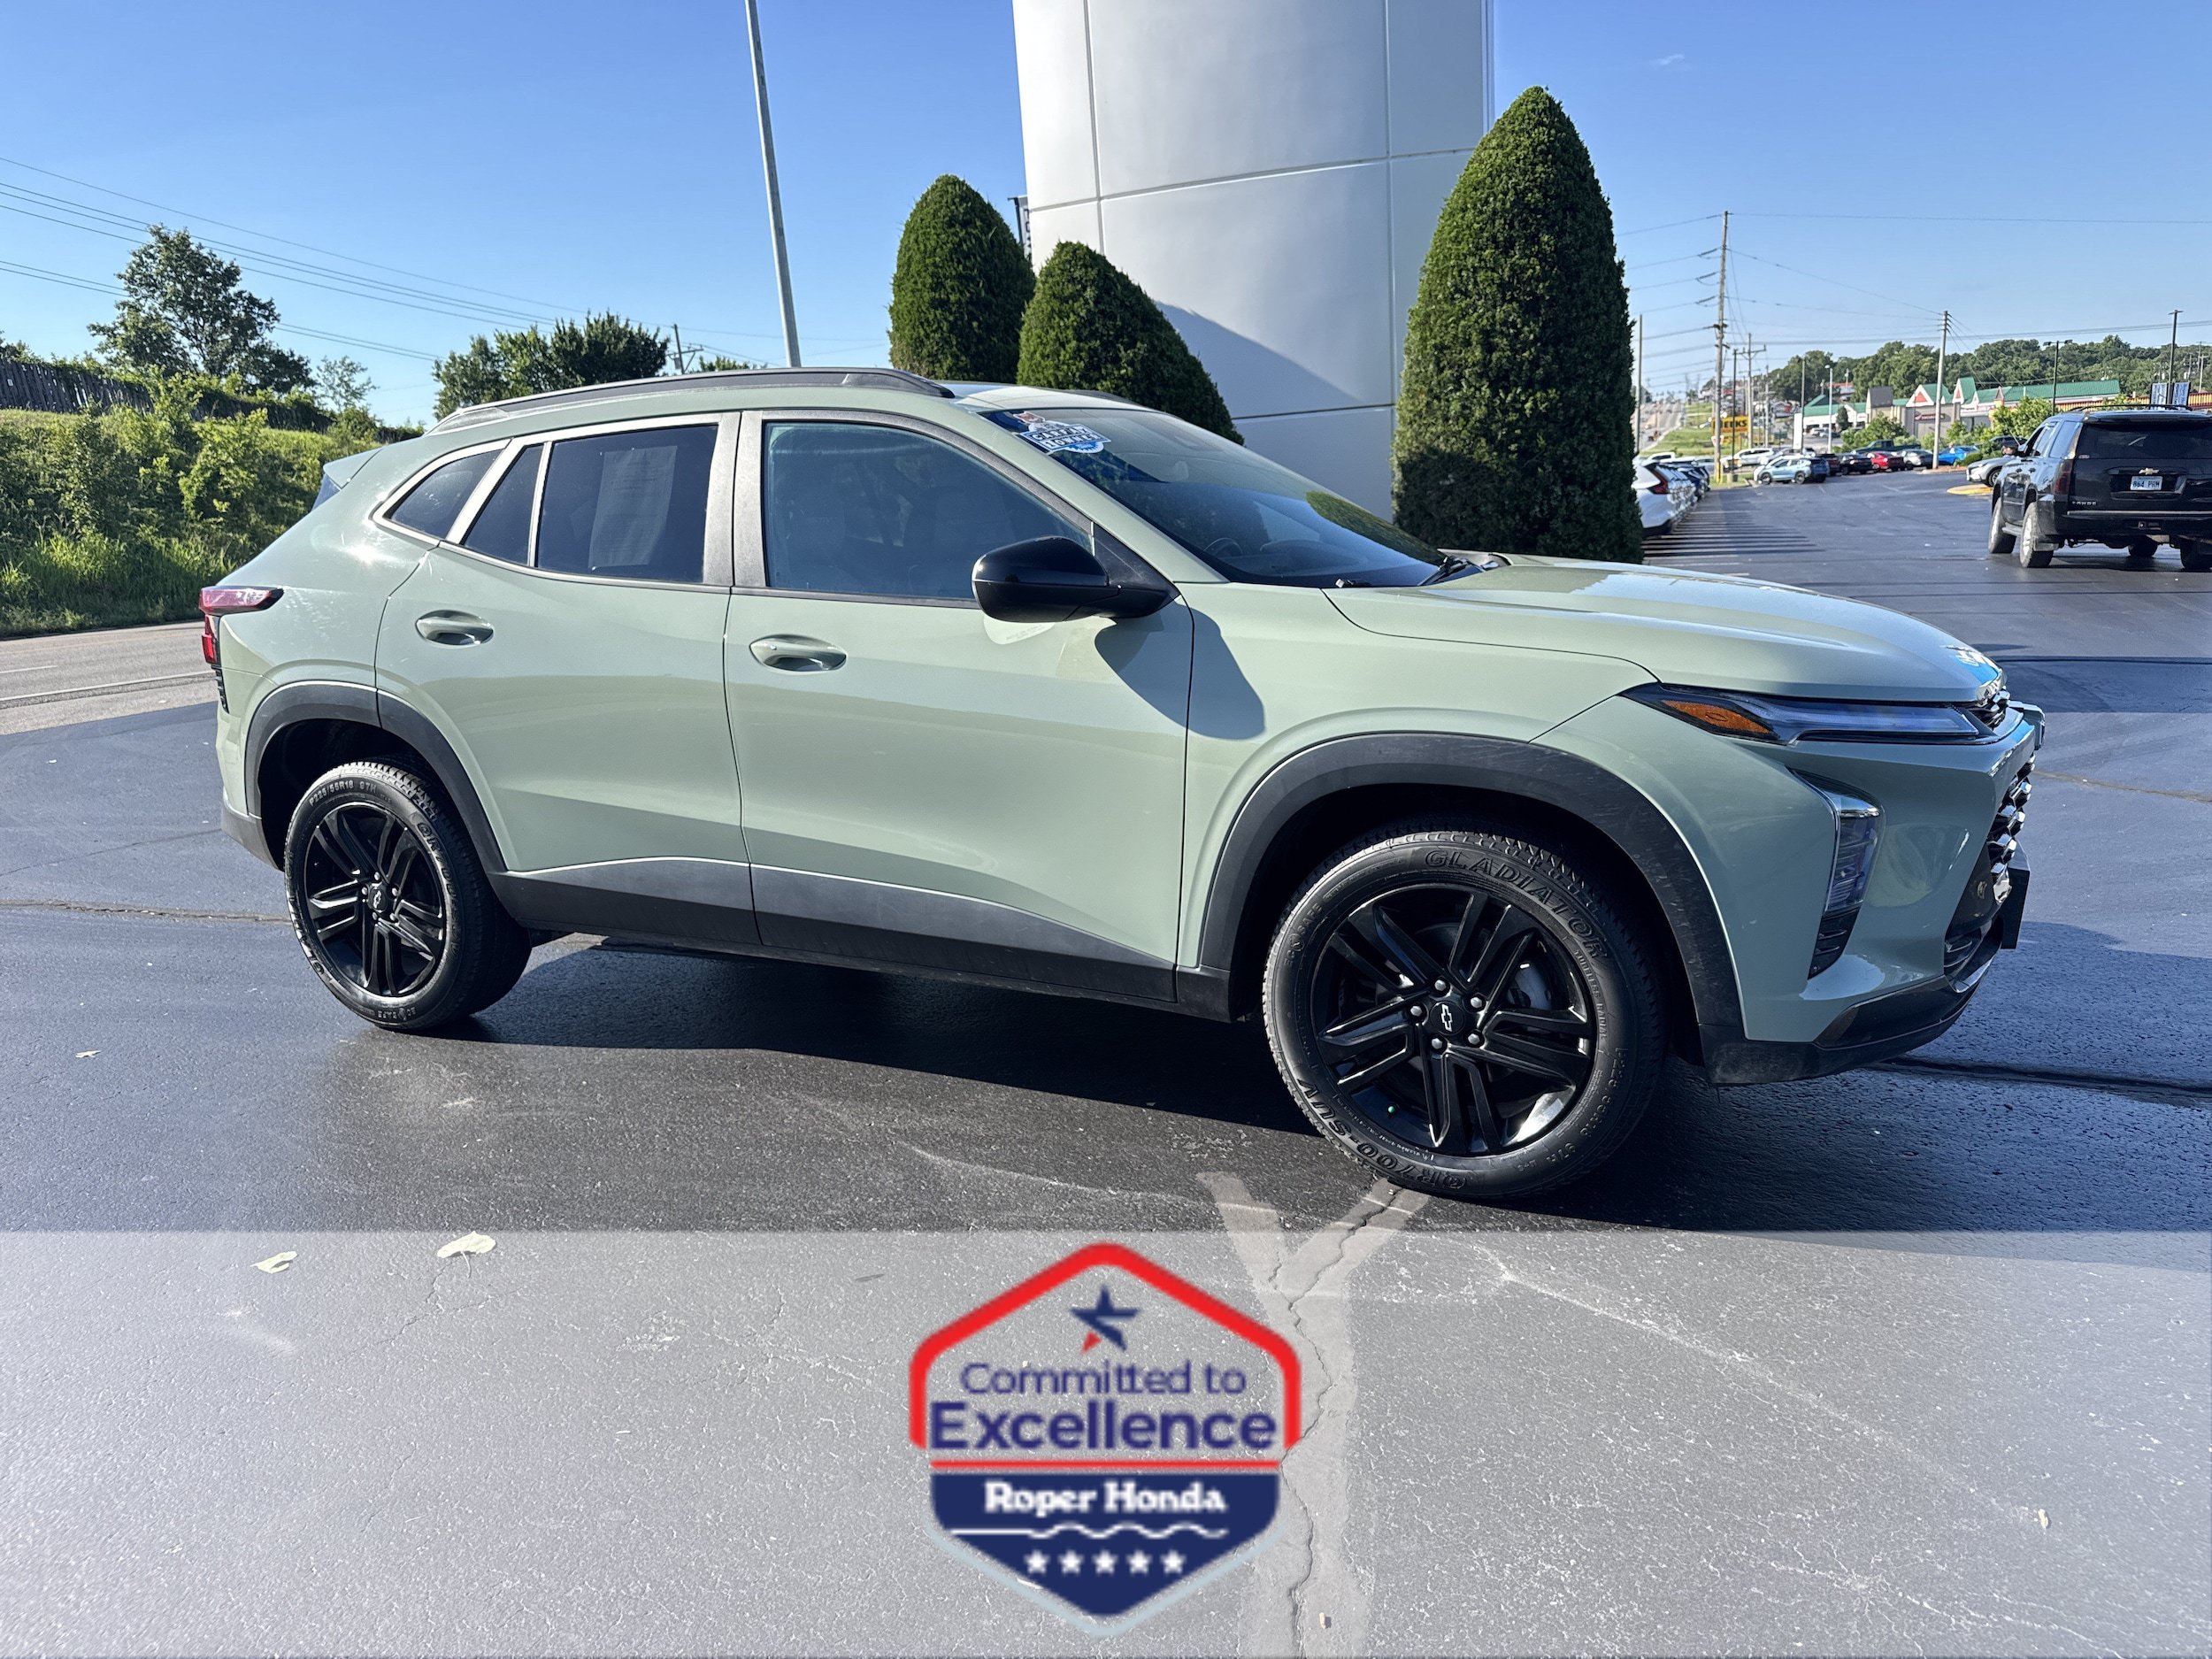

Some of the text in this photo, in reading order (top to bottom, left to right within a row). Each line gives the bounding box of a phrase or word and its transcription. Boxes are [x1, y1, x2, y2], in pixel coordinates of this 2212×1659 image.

[1712, 419, 1747, 429] EEKS
[1032, 426, 1091, 441] CARFAX
[1055, 434, 1102, 445] OWNER
[309, 780, 354, 807] P225/55R18
[1425, 849, 1608, 958] GLADIATOR
